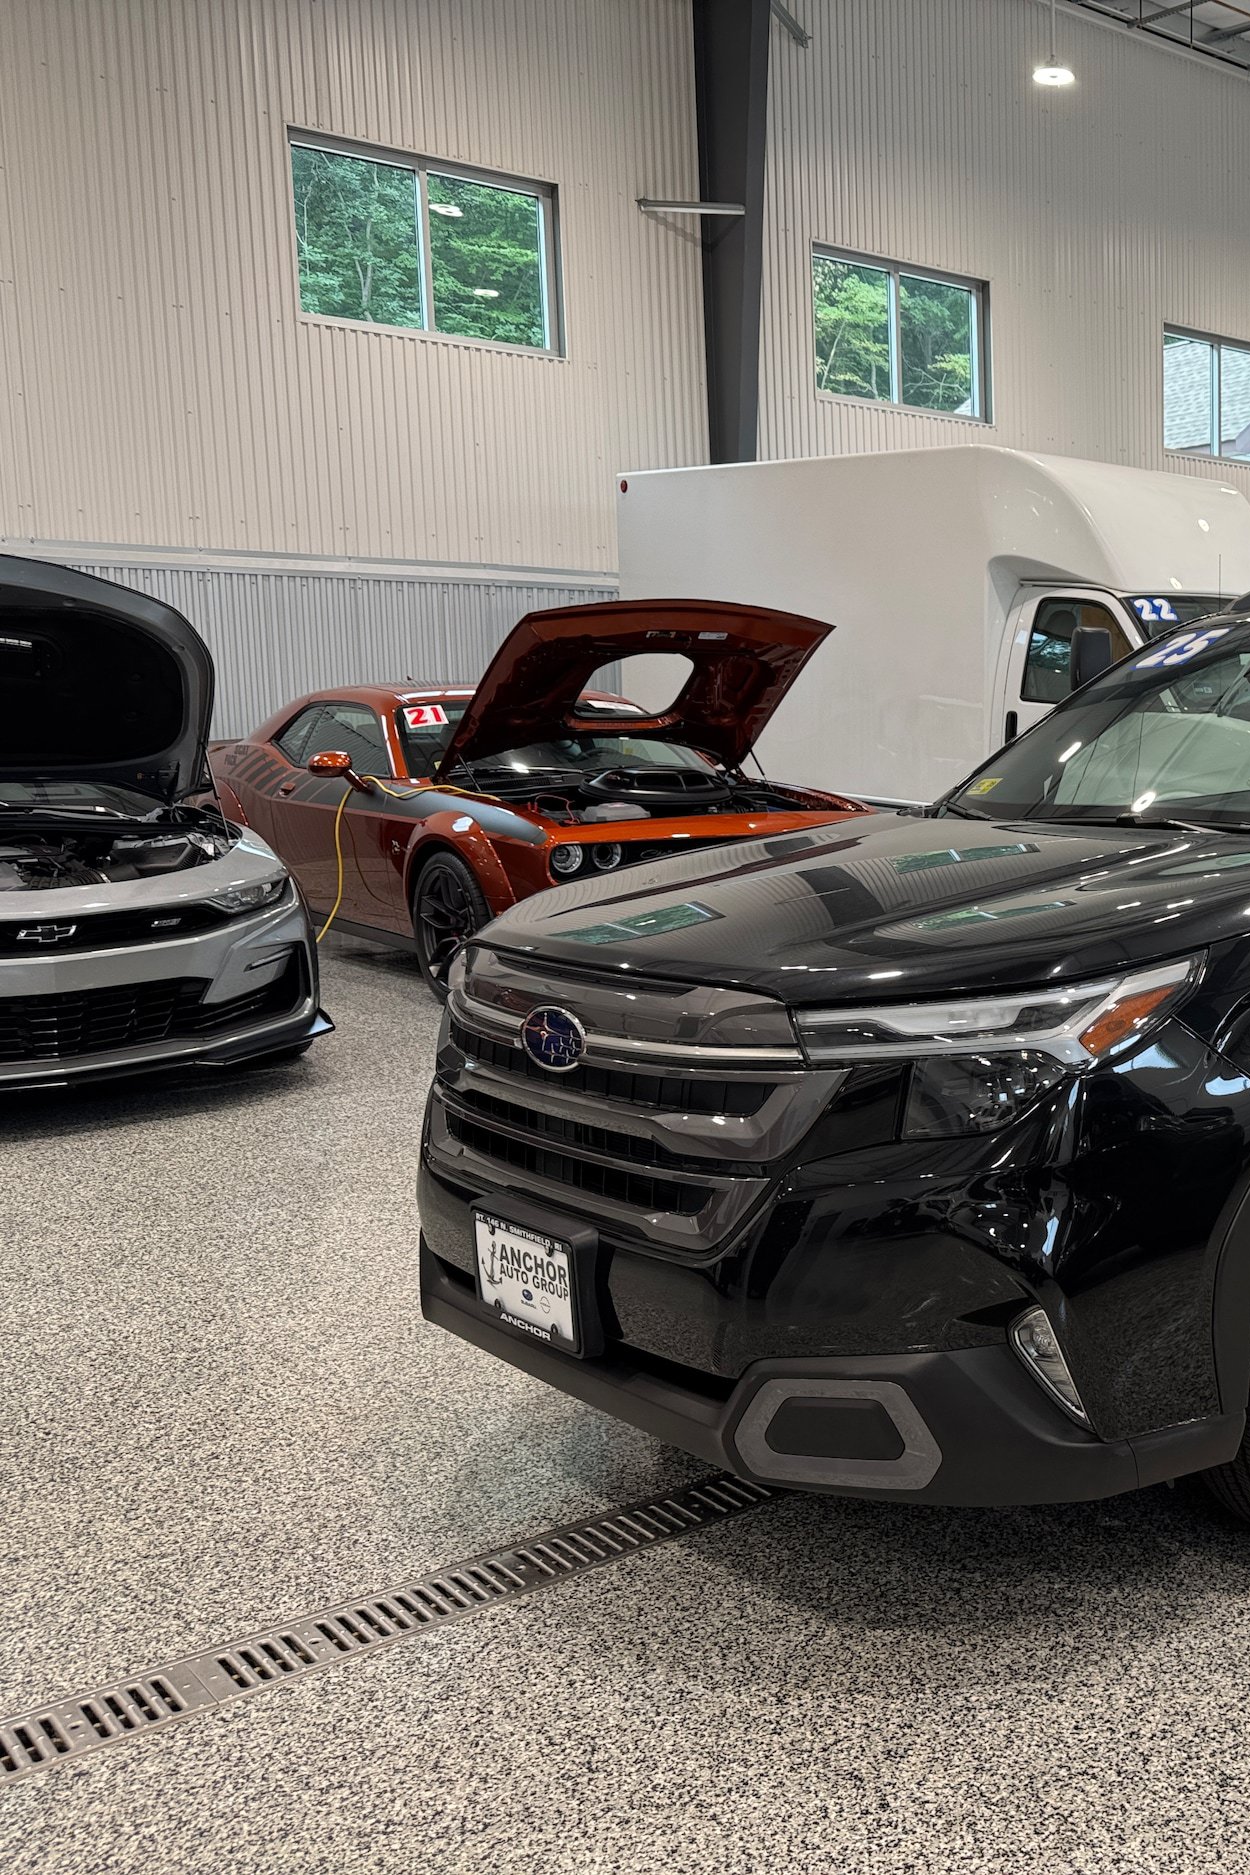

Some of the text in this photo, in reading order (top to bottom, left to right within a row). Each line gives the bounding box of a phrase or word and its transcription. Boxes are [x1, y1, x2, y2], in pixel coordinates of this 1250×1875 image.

[1133, 598, 1178, 621] 22
[1136, 628, 1230, 669] 25
[407, 707, 442, 725] 21
[554, 1242, 563, 1251] RI
[499, 1243, 568, 1288] ANCHOR
[500, 1263, 569, 1301] AUTO GROUP
[500, 1312, 552, 1341] ANCHOR
